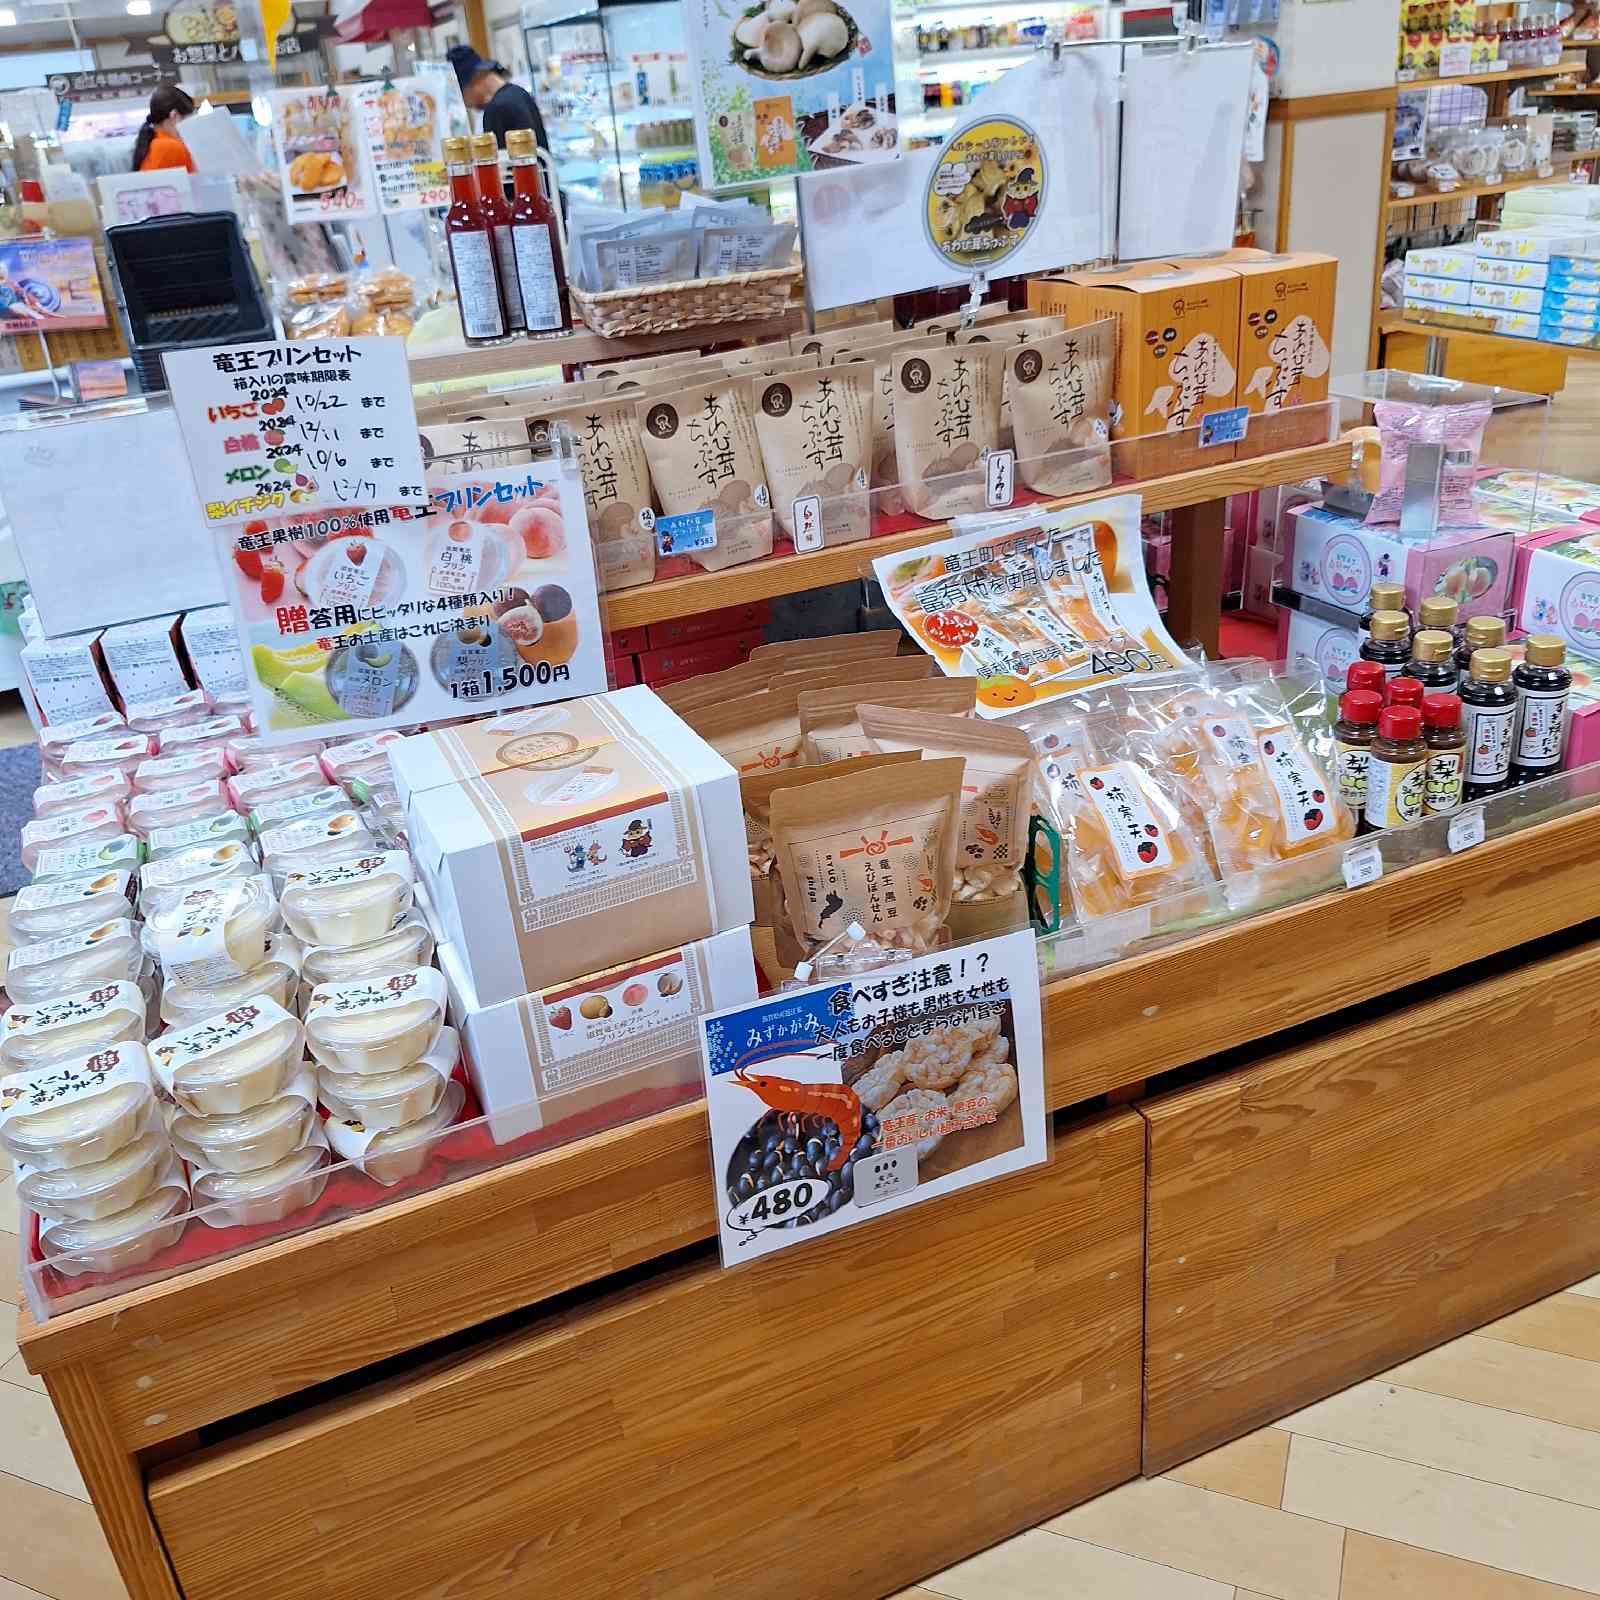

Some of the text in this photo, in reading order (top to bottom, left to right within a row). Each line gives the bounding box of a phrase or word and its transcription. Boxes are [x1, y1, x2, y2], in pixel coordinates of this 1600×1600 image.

[212, 344, 363, 373] 竜王プリンセット
[233, 369, 352, 391] 箱入りの賞味期限表
[207, 402, 260, 424] いちご
[360, 396, 386, 407] まで
[359, 427, 385, 439] まで
[224, 464, 272, 484] メロン
[369, 457, 395, 468] まで
[399, 485, 423, 497] まで
[237, 508, 391, 551] 竜王果樹100%使用
[915, 550, 1104, 614] 富有柿を使用しました
[315, 615, 491, 651] 竜王お土産はこれに決まり
[449, 662, 571, 700] 1箱1,500円
[878, 858, 898, 920] 竜王黒豆
[814, 976, 1010, 1043] 大人もお子様も男性も女性も
[745, 1014, 819, 1048] みずかがみ
